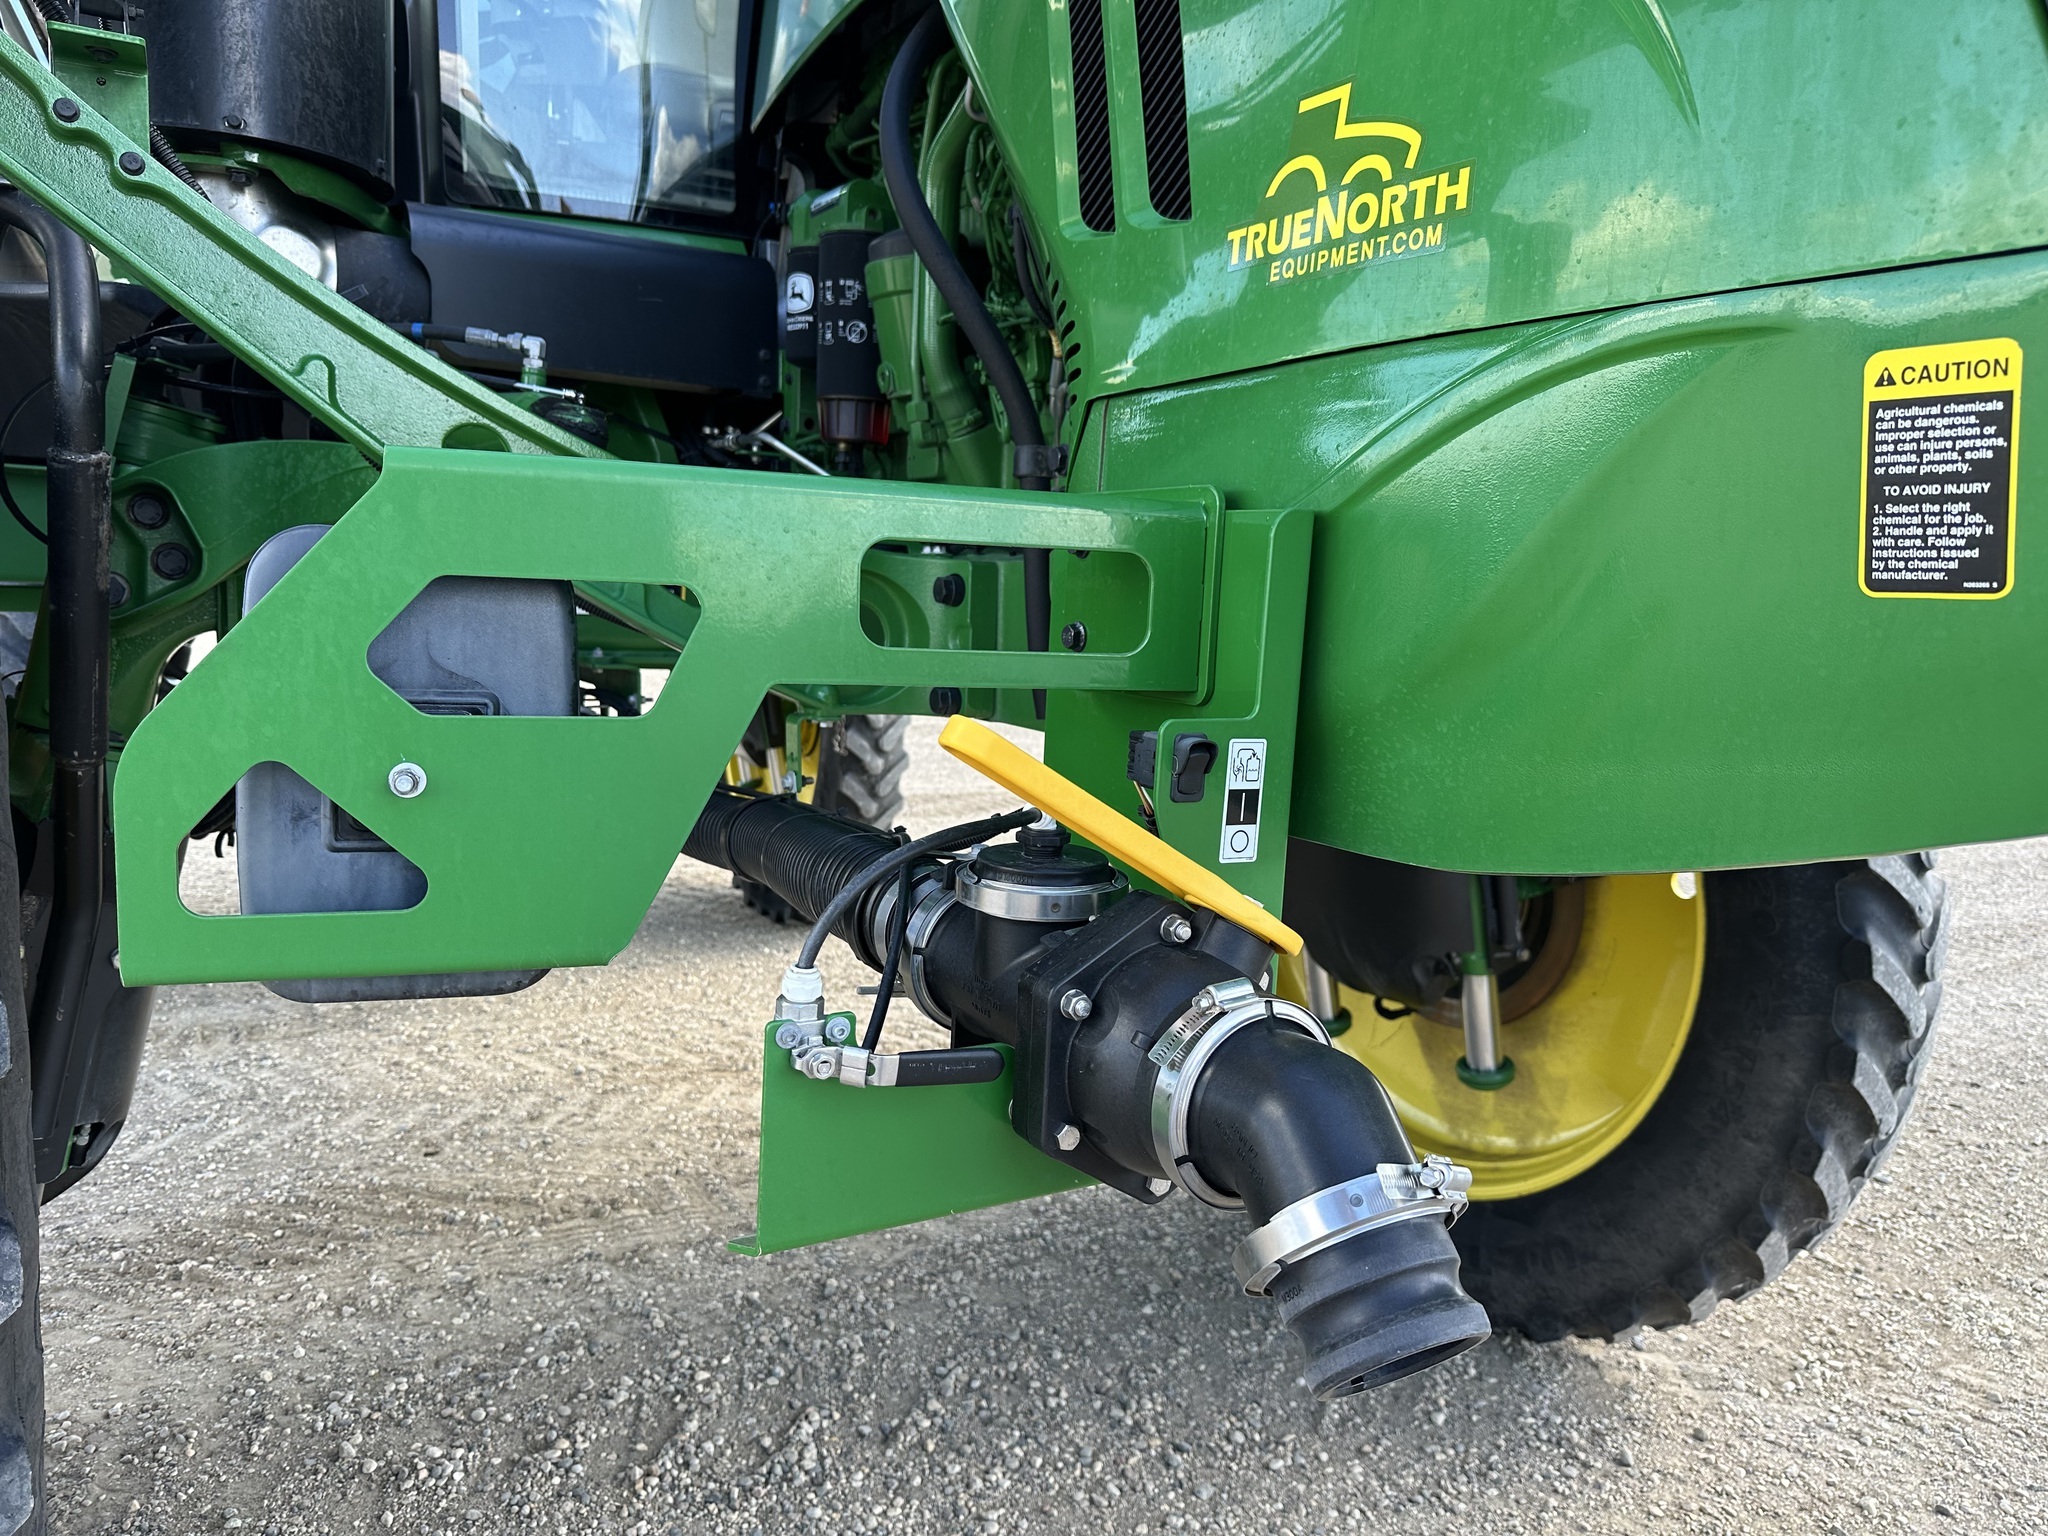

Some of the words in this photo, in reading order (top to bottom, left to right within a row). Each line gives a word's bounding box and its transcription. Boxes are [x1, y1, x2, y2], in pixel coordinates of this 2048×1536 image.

[1269, 223, 1442, 282] EQUIPMENT.COM
[1901, 357, 2009, 385] CAUTION
[1876, 404, 1940, 420] Agricultural
[1943, 400, 2004, 414] chemicals
[1875, 420, 1895, 430] can
[1898, 419, 1911, 428] be
[1914, 415, 1979, 428] dangerous.
[1875, 430, 1925, 442] Improper
[1928, 425, 1980, 438] selection
[1983, 425, 1997, 435] or
[1875, 443, 1894, 452] use
[1897, 442, 1917, 451] can
[1920, 439, 1953, 453] injure
[1956, 437, 2008, 451] persons,
[1875, 452, 1920, 464] animals,
[1923, 450, 1962, 463] plants,
[1965, 448, 1993, 459] soils
[1874, 466, 1886, 474] or
[1888, 462, 1917, 474] other
[1920, 461, 1972, 475] property.
[1883, 486, 1900, 496] TO
[1902, 484, 1941, 495] AVOID
[1944, 482, 1991, 494] INJURY
[1874, 504, 1882, 513] 1.
[1885, 503, 1919, 513] Select
[1922, 502, 1940, 512] the
[1943, 502, 1970, 514] right
[1873, 514, 1921, 525] chemical
[1924, 514, 1940, 523] for
[1943, 514, 1962, 523] the
[1965, 513, 1987, 525] job.
[1872, 527, 1882, 536] 2.
[1885, 526, 1923, 535] Handle
[1926, 525, 1947, 535] and
[1950, 525, 1982, 537] apply
[1985, 525, 1993, 535] it
[1872, 537, 1895, 546] with
[1897, 537, 1924, 546] care.
[1928, 537, 1966, 546] Follow
[1872, 548, 1938, 558] instructions
[1940, 548, 1979, 558] issued
[1872, 560, 1885, 571] by
[1888, 559, 1905, 569] the
[1908, 559, 1958, 569] chemical
[1872, 570, 1948, 580] manufacturer.
